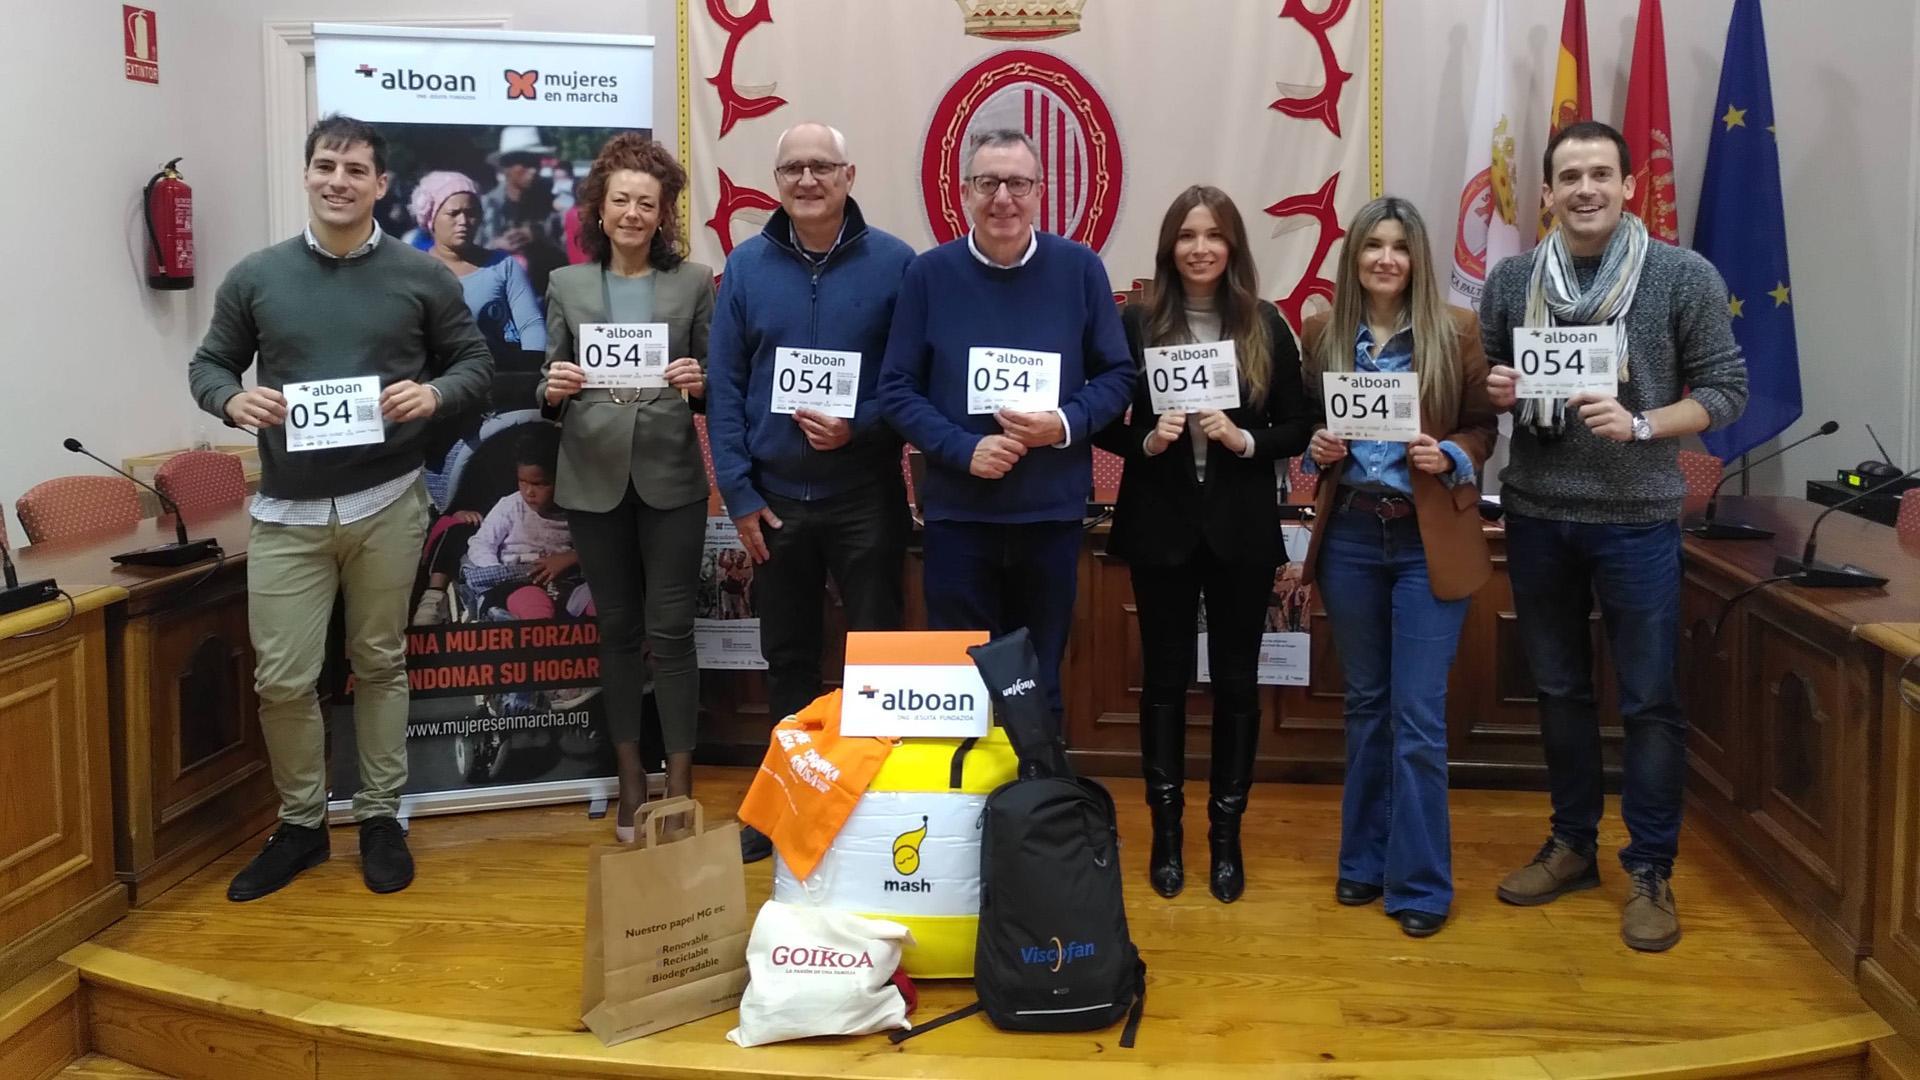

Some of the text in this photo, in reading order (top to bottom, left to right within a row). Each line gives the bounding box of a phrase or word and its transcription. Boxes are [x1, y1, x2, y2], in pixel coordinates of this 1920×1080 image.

[381, 69, 476, 92] alboan
[545, 71, 617, 90] mujeres
[545, 92, 618, 103] en marcha
[606, 328, 653, 338] alboan
[1544, 331, 1598, 344] alboan
[586, 344, 642, 367] 054
[801, 353, 846, 367] alboan
[996, 353, 1044, 366] alboan
[1170, 348, 1219, 361] alboan
[1521, 349, 1585, 375] 054
[312, 383, 362, 397] alboan
[779, 368, 833, 395] 054
[974, 367, 1031, 393] 054
[1153, 364, 1209, 393] 054
[1351, 377, 1401, 388] alboan
[290, 399, 352, 429] 054
[1331, 393, 1389, 419] 054
[446, 626, 514, 653] MUJER
[520, 623, 600, 649] FORZAD
[408, 664, 494, 691] NDONAR
[500, 662, 527, 684] SU
[532, 657, 600, 682] HOGAR
[882, 689, 975, 712] alboan
[405, 709, 590, 738] www.mujeresenmarcha.org
[884, 878, 931, 893] mash
[625, 923, 667, 939] Nuestro
[670, 914, 695, 931] papel
[697, 907, 712, 920] MG
[662, 933, 709, 954] Renovable
[663, 946, 709, 967] Reciclable
[772, 946, 874, 968] GOIKOA
[652, 957, 720, 983] Biodegradable
